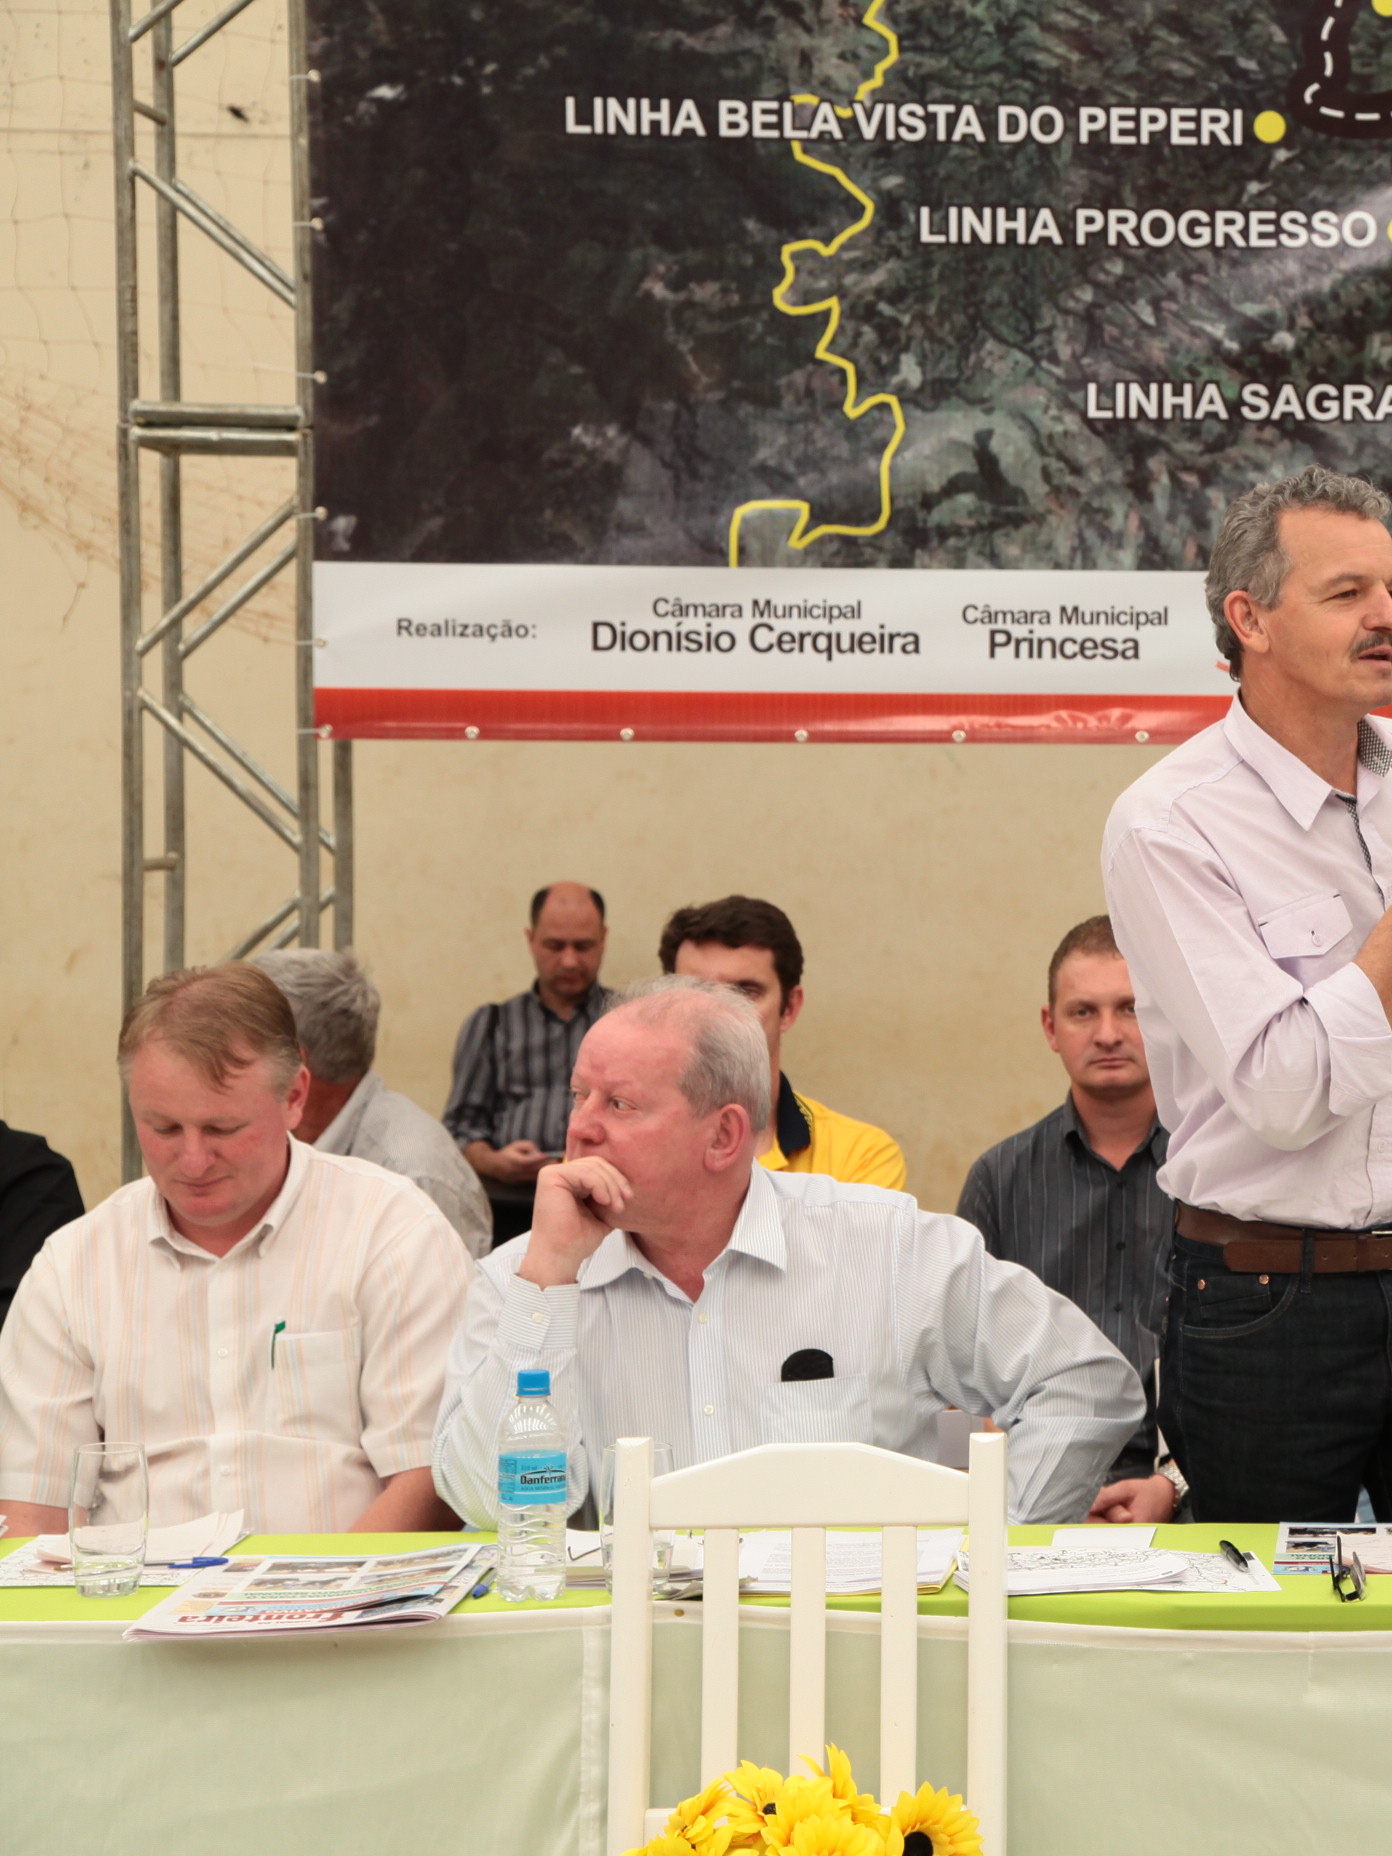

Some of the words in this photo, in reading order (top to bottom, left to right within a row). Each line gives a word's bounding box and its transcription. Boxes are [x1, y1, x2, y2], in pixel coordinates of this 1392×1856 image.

[566, 97, 706, 136] LINHA
[719, 100, 842, 139] BELA
[853, 103, 985, 141] VISTA
[998, 106, 1064, 143] DO
[1079, 107, 1243, 145] PEPERI
[919, 207, 1062, 244] LINHA
[1076, 208, 1378, 248] PROGRESSO
[1087, 382, 1228, 418] LINHA
[652, 597, 743, 619] Câmara
[752, 599, 862, 622] Municipal
[962, 603, 1050, 626] Câmara
[1059, 604, 1169, 628] Municipal
[396, 617, 538, 643] Realização:
[591, 620, 737, 654] Dionísio
[748, 623, 921, 662] Cerqueira
[988, 629, 1140, 661] Princesa
